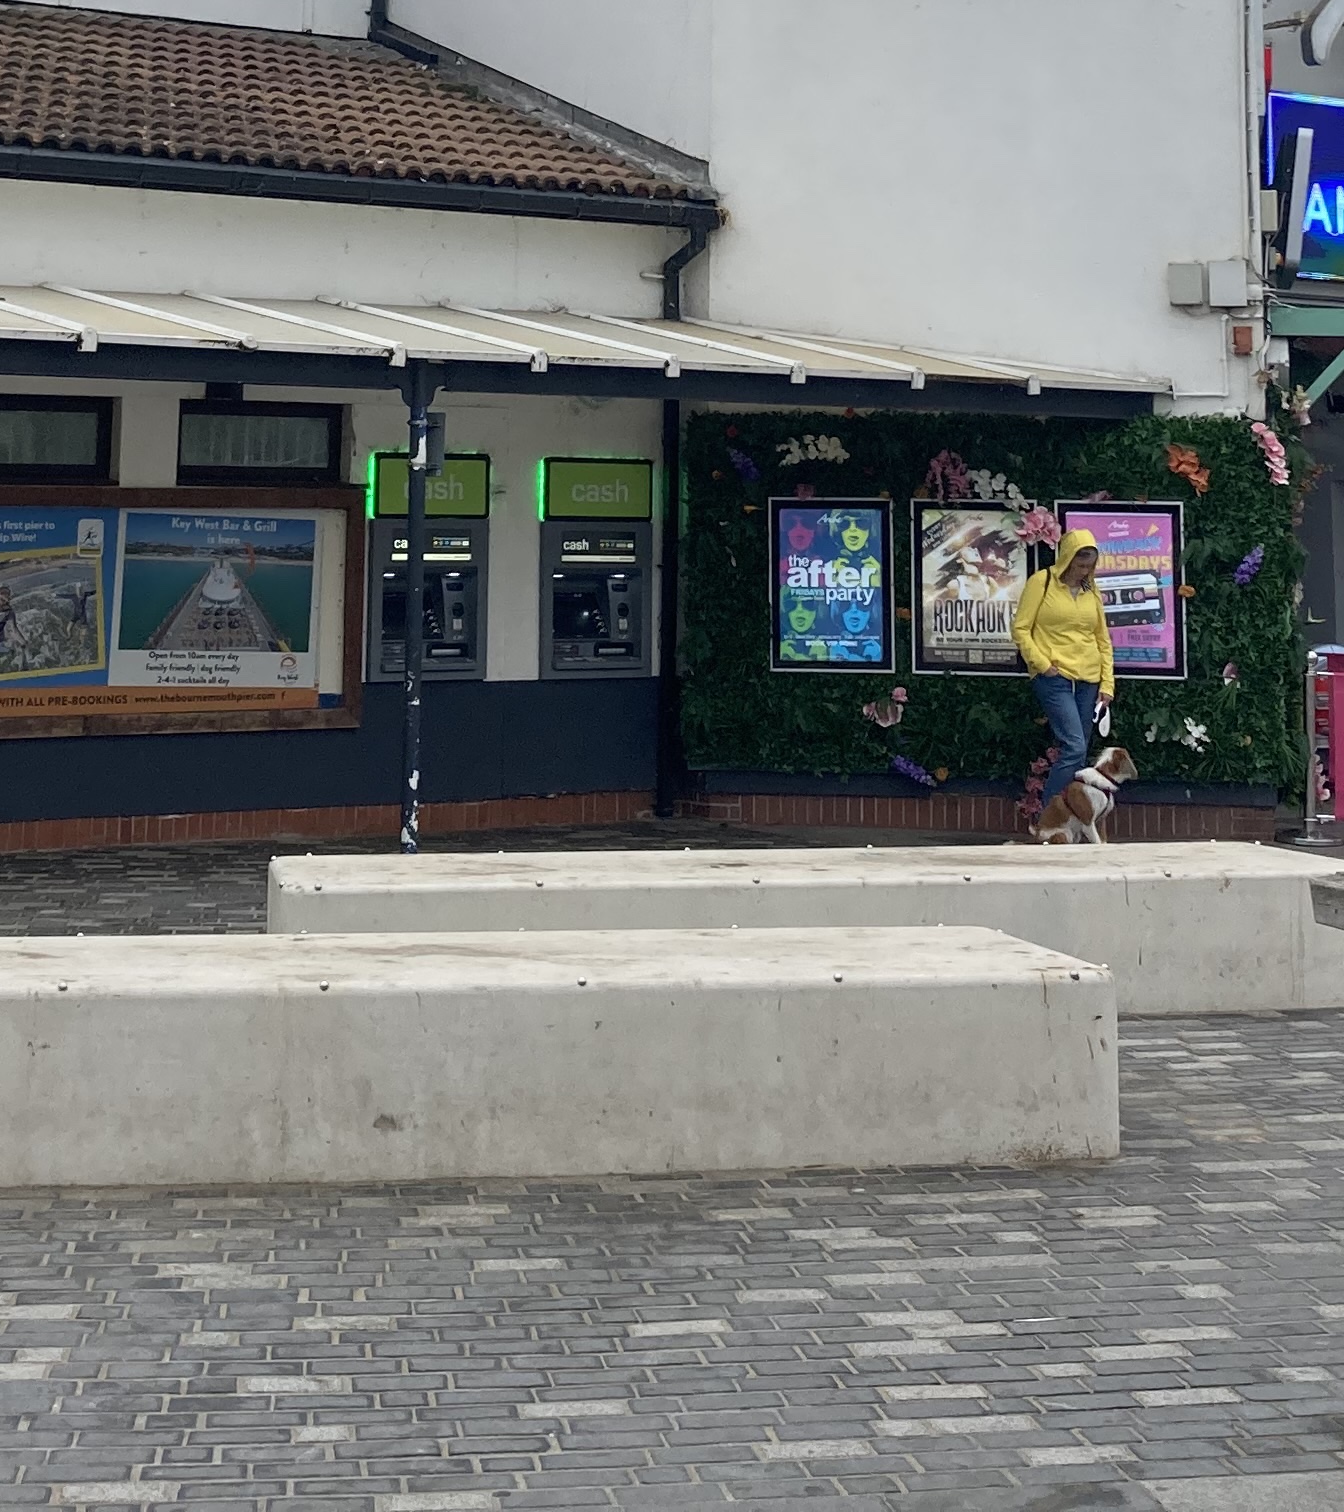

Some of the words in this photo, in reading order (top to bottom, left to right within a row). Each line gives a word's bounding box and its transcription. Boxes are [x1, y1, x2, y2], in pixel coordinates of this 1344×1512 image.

[570, 476, 629, 505] cash
[3, 520, 23, 530] first
[24, 521, 44, 532] pier
[45, 521, 56, 530] to
[171, 516, 191, 533] Key
[194, 518, 220, 530] West
[222, 519, 239, 531] Bar
[242, 519, 252, 532] &
[254, 520, 278, 533] Grill
[11, 533, 36, 543] Wire!
[207, 534, 215, 544] is
[218, 533, 241, 545] here
[563, 538, 589, 551] cash
[788, 554, 810, 567] the
[786, 559, 877, 588] after
[825, 587, 875, 606] party
[148, 651, 168, 661] Open
[169, 651, 186, 659] from
[207, 653, 226, 662] every
[227, 653, 240, 662] day
[169, 663, 196, 673] friendly
[200, 664, 213, 674] dog
[208, 676, 216, 684] all
[217, 676, 230, 686] day
[25, 697, 46, 707] ALL
[47, 695, 128, 706] PRE-BOOKINGS
